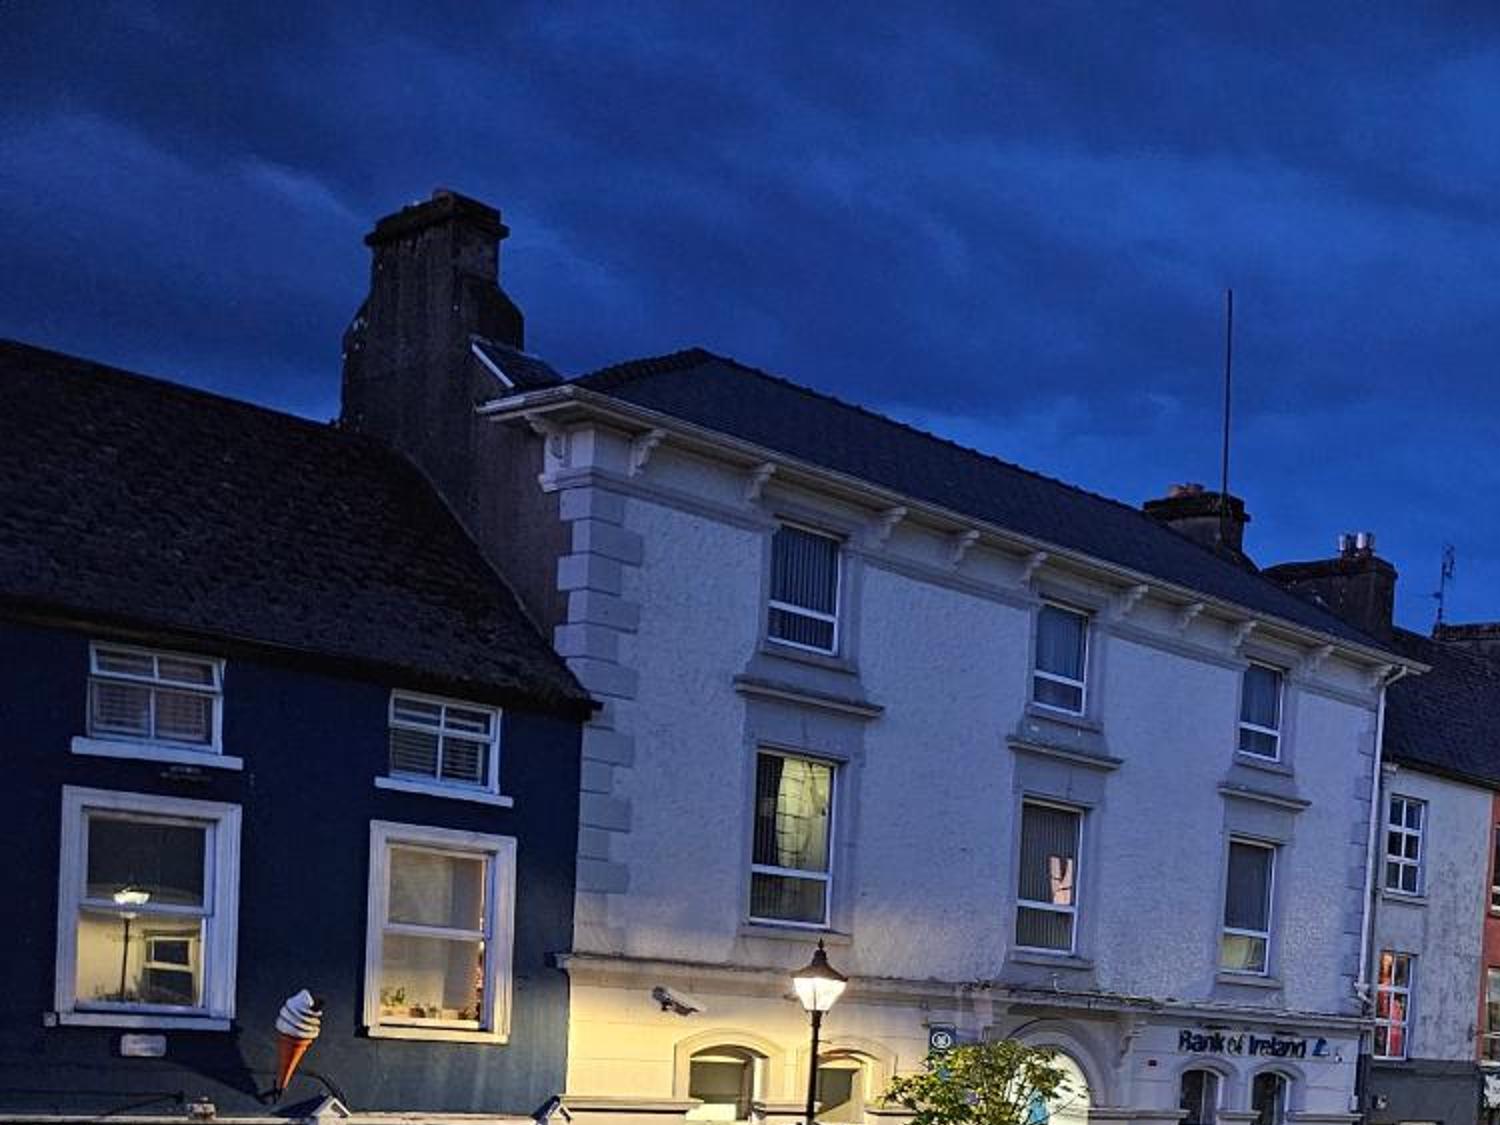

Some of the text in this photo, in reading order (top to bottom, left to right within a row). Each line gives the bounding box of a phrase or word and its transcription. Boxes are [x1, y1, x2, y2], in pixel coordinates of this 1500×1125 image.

[1178, 1029, 1307, 1059] Bank of Ireland
